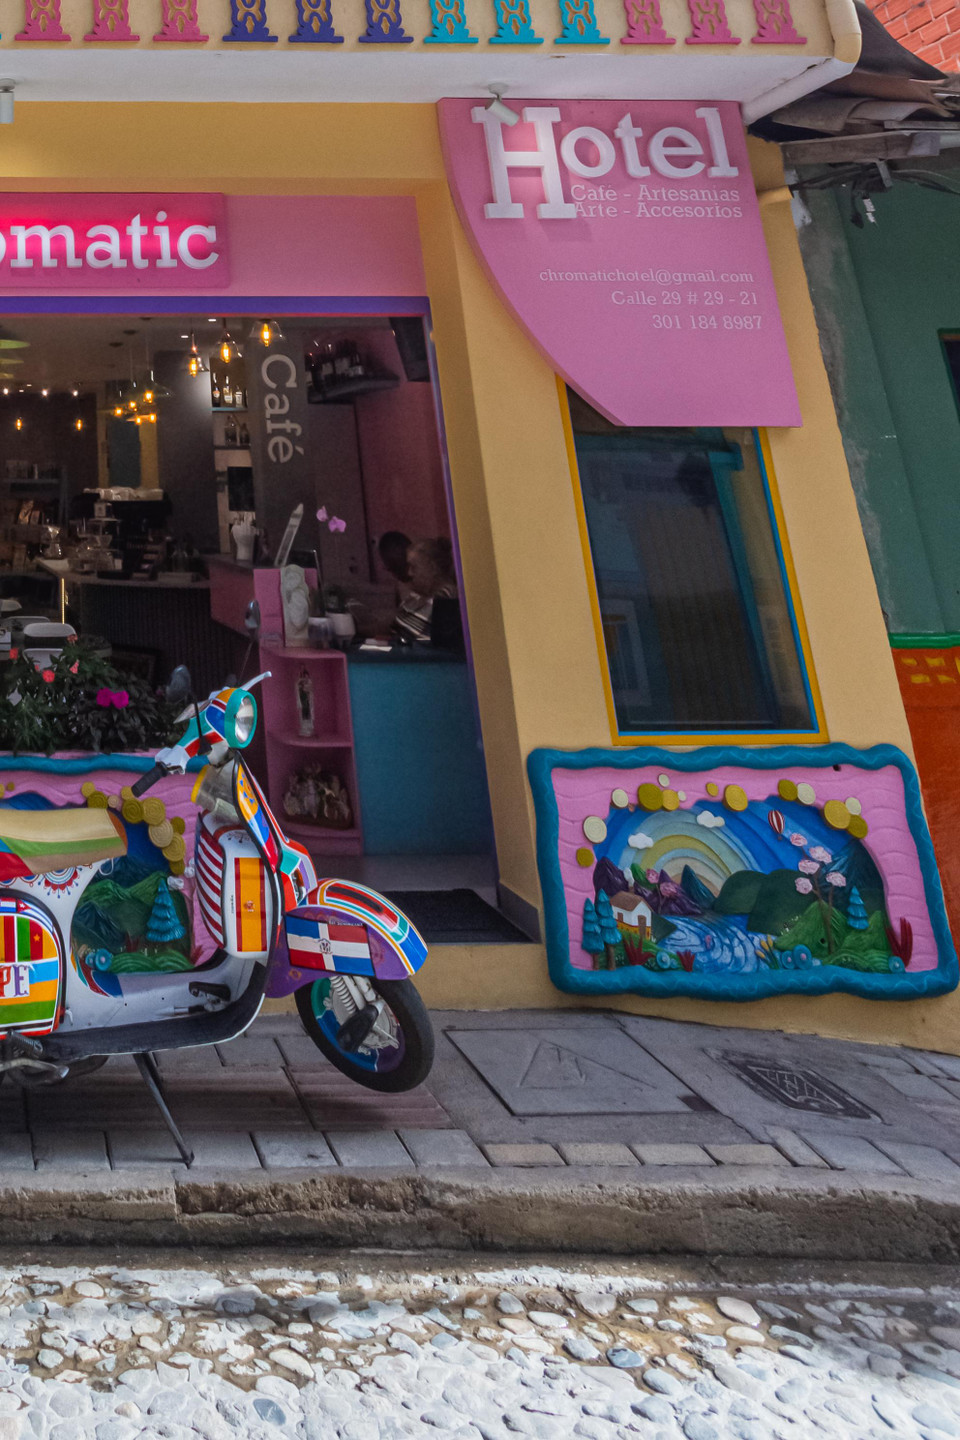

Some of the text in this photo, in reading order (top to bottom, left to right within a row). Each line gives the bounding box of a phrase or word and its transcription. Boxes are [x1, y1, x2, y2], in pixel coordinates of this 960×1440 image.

[471, 107, 739, 219] Hotel
[571, 184, 618, 201] Café
[575, 202, 618, 218] Arte
[637, 202, 743, 218] Accesorios
[539, 268, 755, 286] chromatichotel@gmail.com
[611, 291, 657, 306] Calle
[661, 291, 681, 306] 29
[686, 291, 699, 305] #
[703, 291, 724, 306] 29
[741, 292, 758, 306] 21
[652, 315, 763, 330] 301 184 8987
[261, 354, 304, 464] Café
